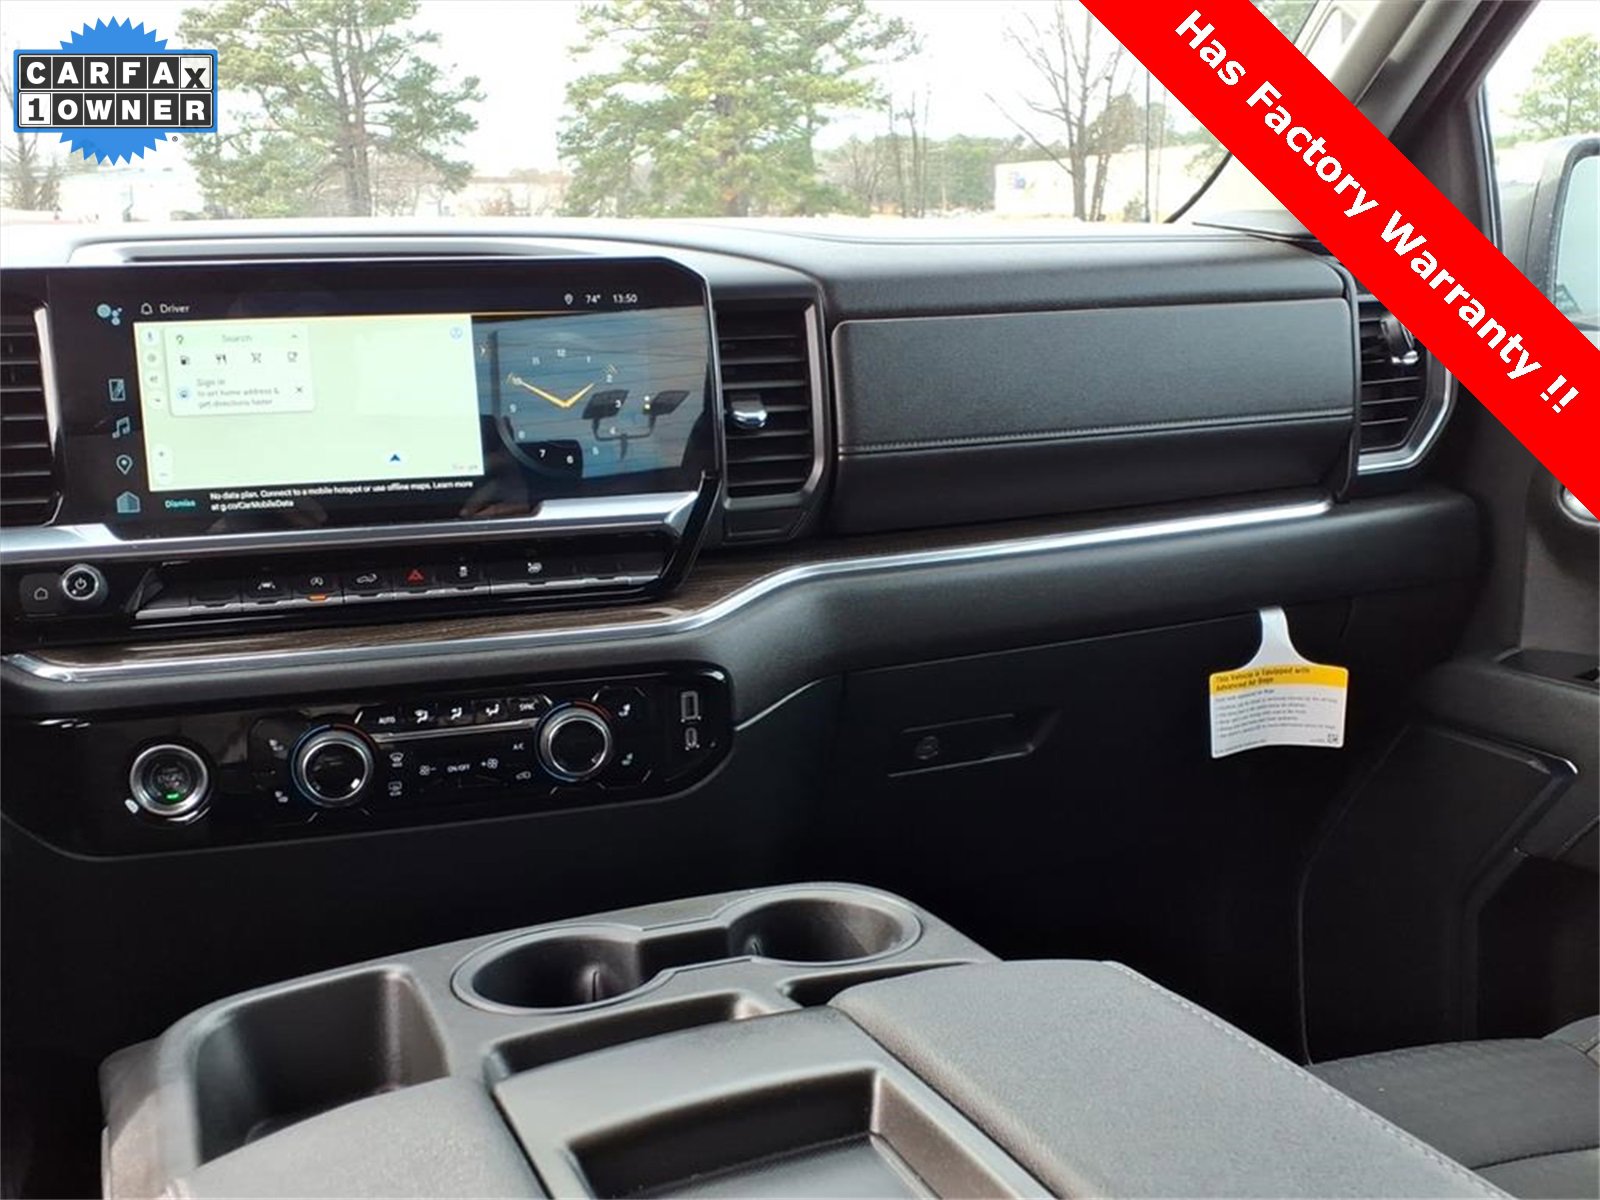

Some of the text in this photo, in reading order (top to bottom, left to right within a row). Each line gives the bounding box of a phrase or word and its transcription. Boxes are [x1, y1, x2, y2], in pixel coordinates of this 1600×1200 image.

[612, 294, 638, 303] 13:50
[159, 303, 190, 313] Driver
[222, 334, 252, 343] Search
[260, 489, 293, 498] Connect
[454, 480, 473, 488] more
[519, 703, 535, 711] SYNC
[378, 716, 396, 724] AUTO
